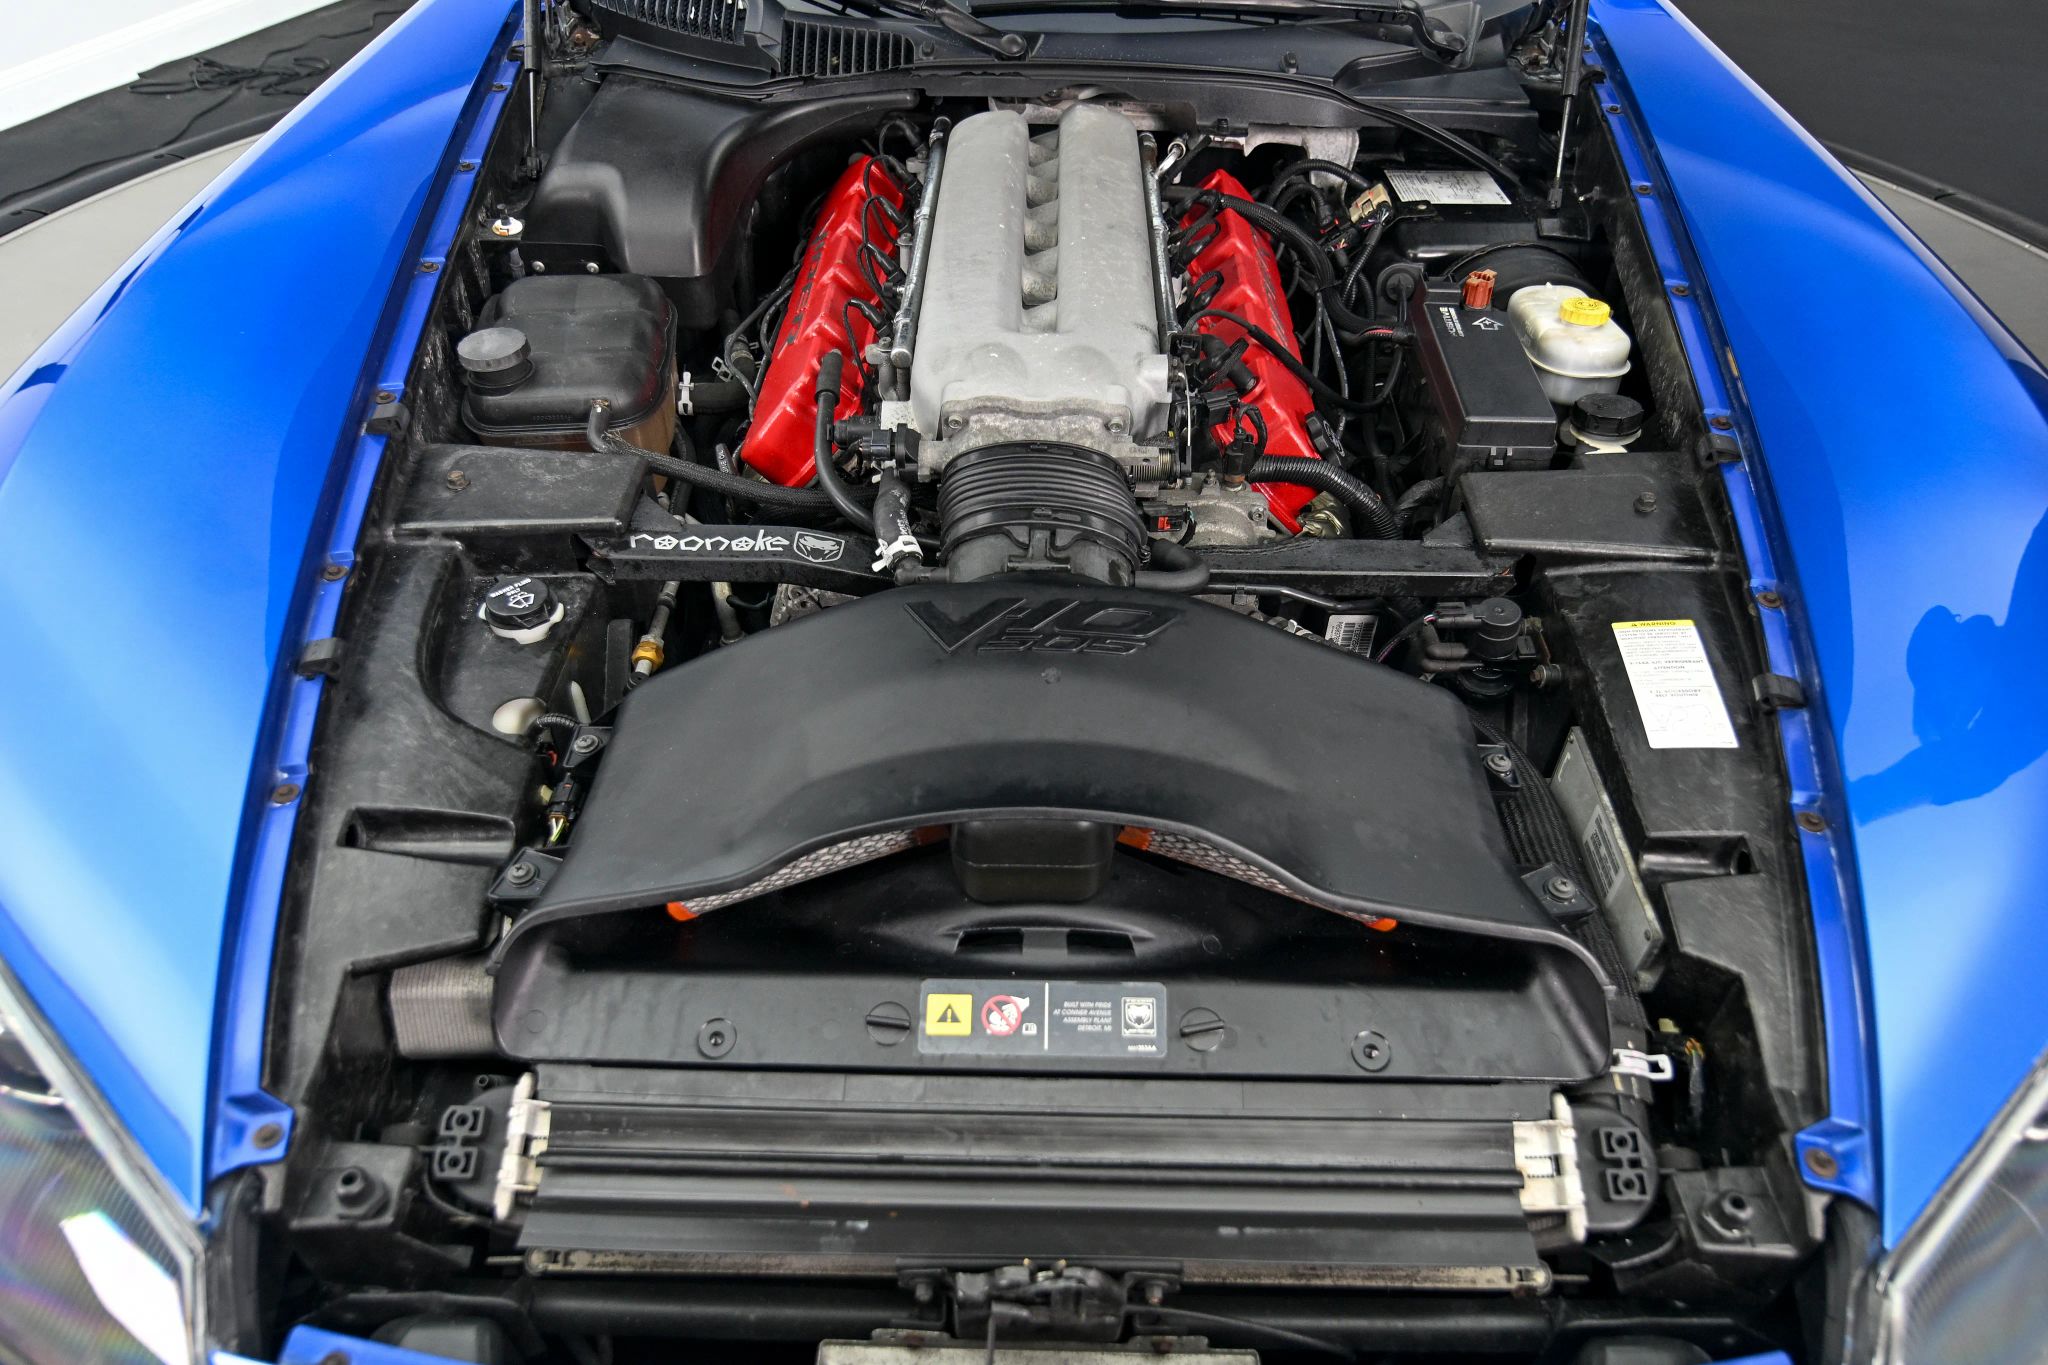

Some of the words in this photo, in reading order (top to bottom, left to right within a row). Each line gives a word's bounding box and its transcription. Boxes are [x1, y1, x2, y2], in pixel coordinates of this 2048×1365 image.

[489, 585, 514, 598] WASHER
[513, 578, 532, 588] FLUID
[506, 588, 521, 596] ONLY
[1053, 1008, 1061, 1016] AT
[1062, 1016, 1092, 1024] ASSEMBLY
[1092, 1016, 1112, 1024] PLANT
